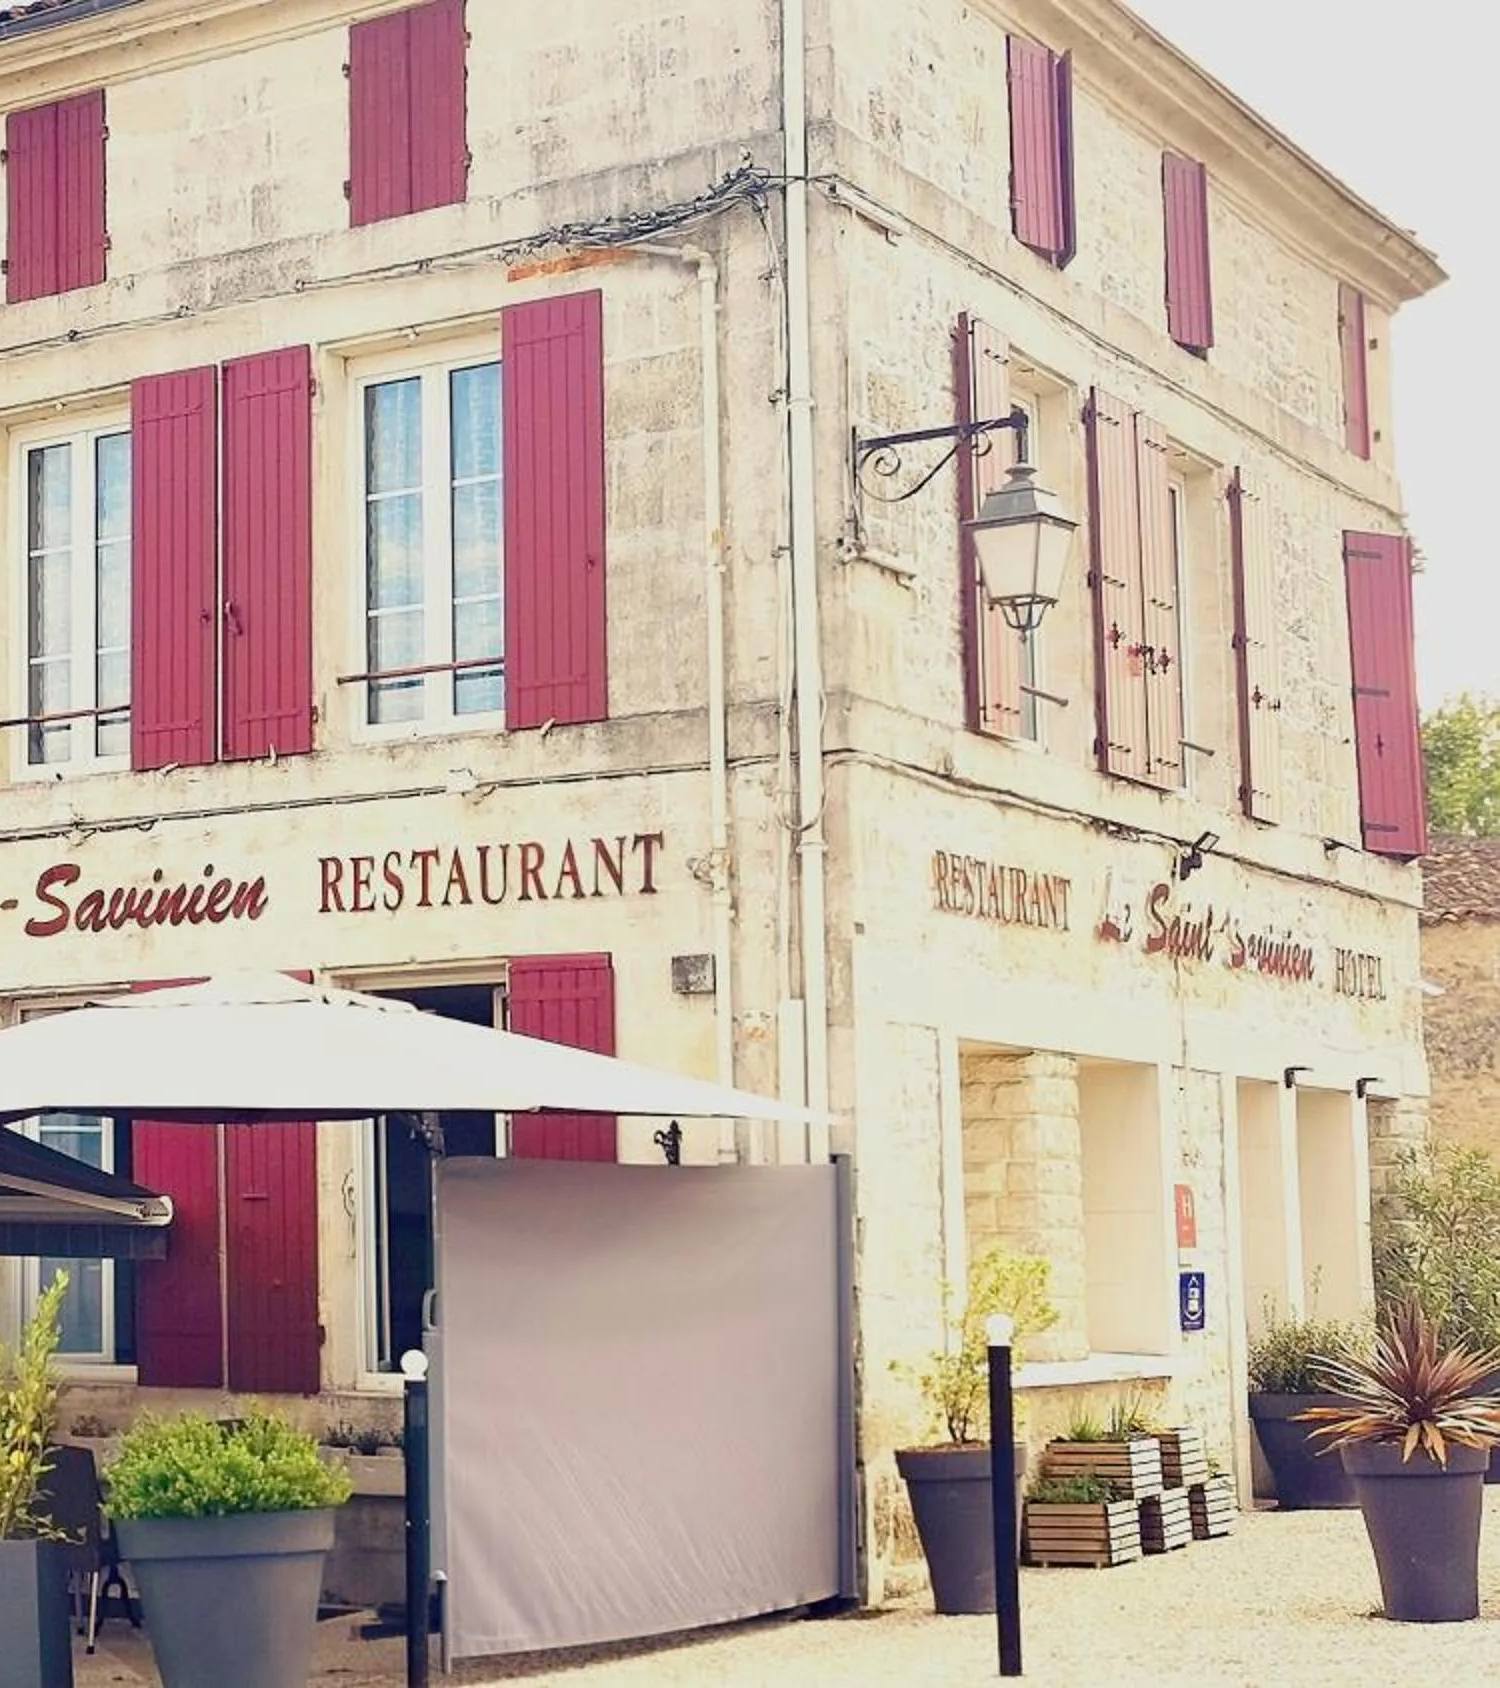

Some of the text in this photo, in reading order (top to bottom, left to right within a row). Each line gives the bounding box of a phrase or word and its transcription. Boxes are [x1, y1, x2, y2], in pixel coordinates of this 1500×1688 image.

[318, 830, 665, 914] RESTAURANT
[932, 849, 1073, 932] RESTAURANT
[1334, 947, 1388, 1002] HOTEL
